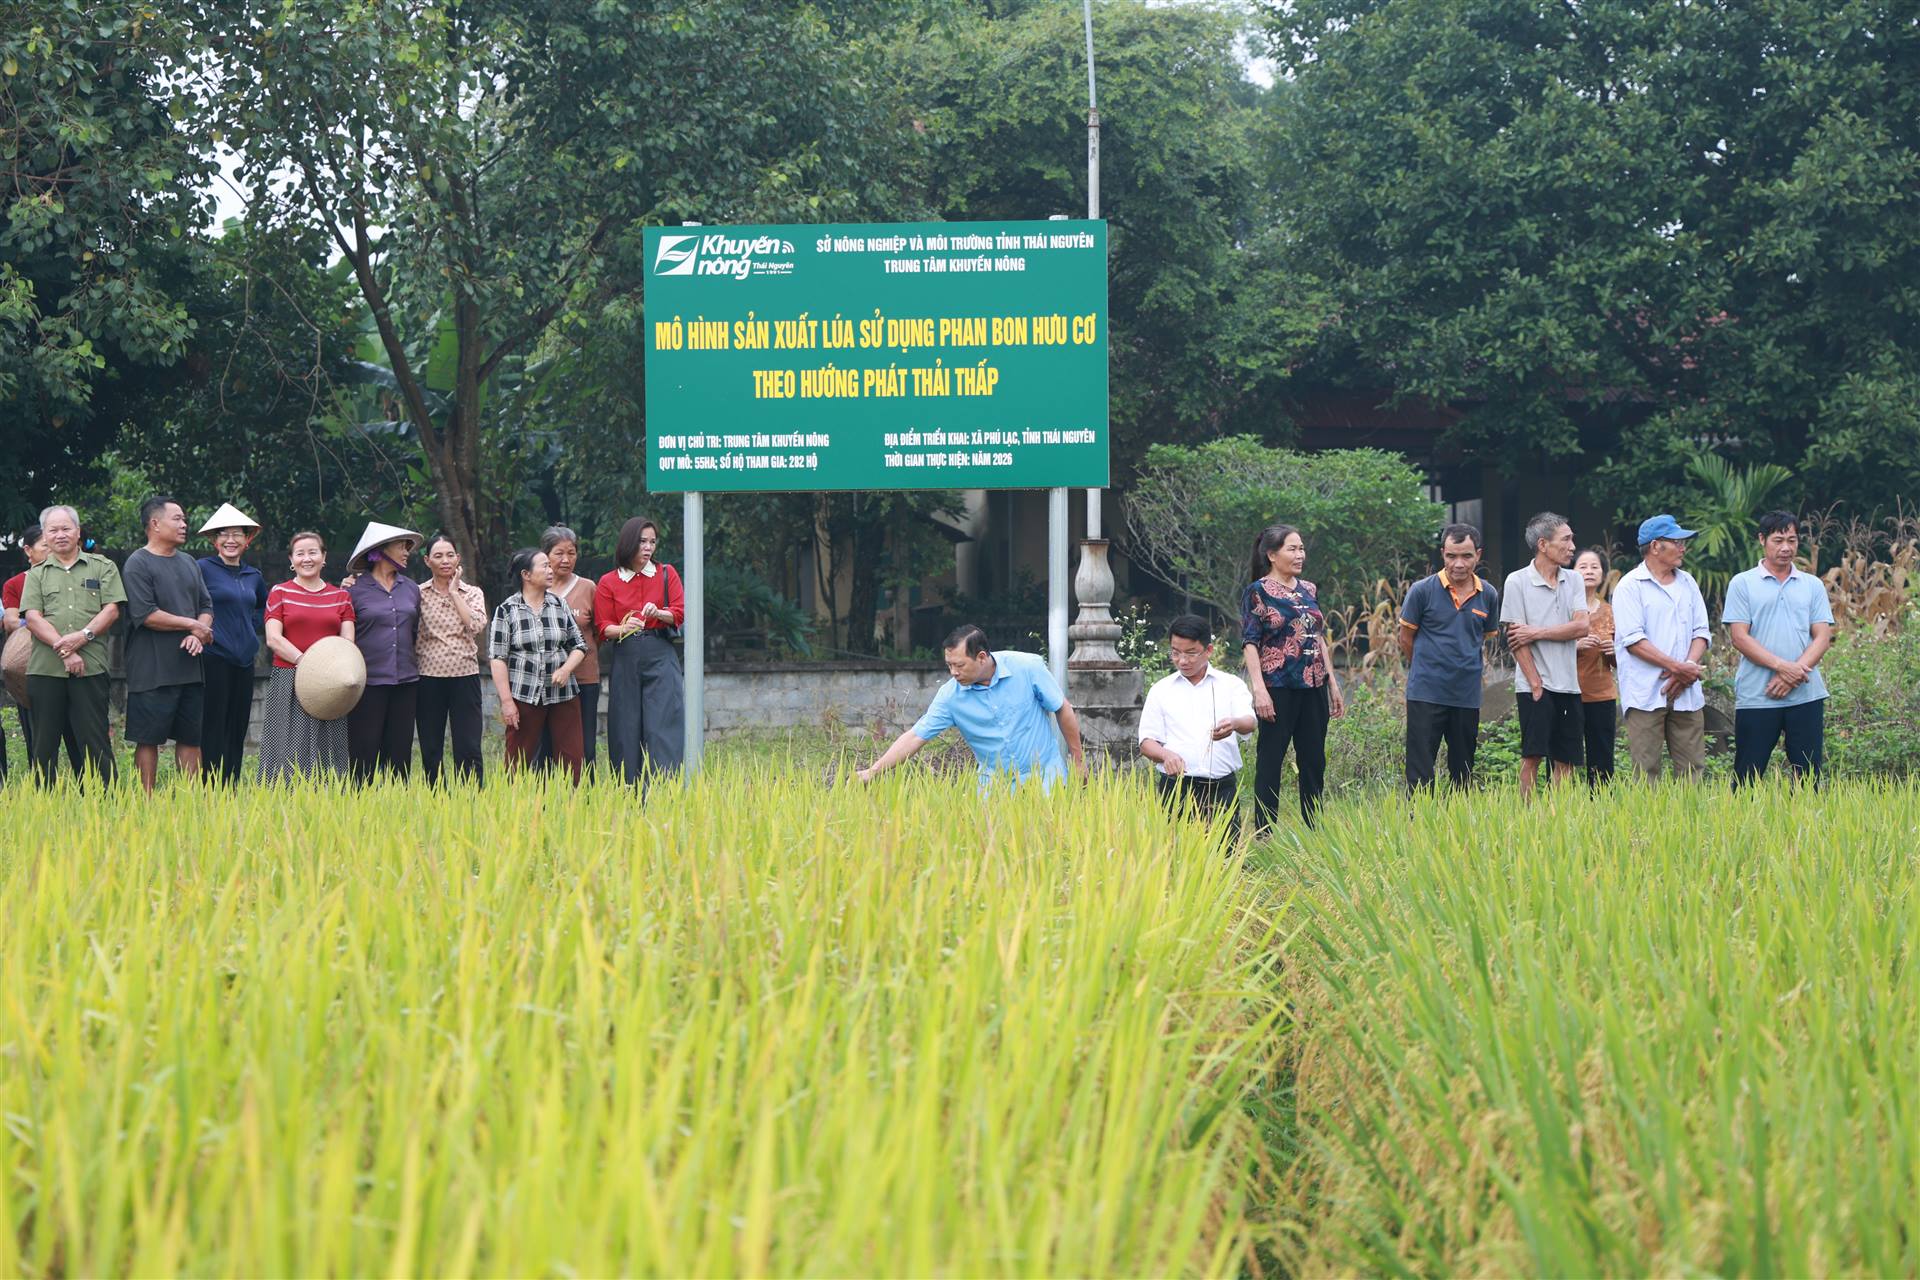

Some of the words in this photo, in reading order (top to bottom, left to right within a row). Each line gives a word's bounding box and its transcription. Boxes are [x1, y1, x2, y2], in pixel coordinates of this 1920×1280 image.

[701, 235, 781, 259] Khuyến
[816, 234, 832, 253] SỞ
[834, 235, 865, 252] NÔNG
[867, 235, 907, 254] NGHIỆP
[909, 234, 924, 251] VÀ
[926, 234, 948, 250] MÔI
[950, 233, 993, 250] TRƯỜNG
[996, 232, 1021, 249] TỈNH
[1023, 232, 1048, 249] THÁI
[1050, 232, 1095, 248] NGUYÊN
[698, 257, 751, 280] nông
[769, 261, 794, 270] Nguyên
[884, 259, 921, 273] TRUNG
[923, 256, 947, 272] TÂM
[950, 254, 992, 272] KHUYẾN
[995, 255, 1026, 271] NÔNG
[656, 315, 683, 350] MÔ
[688, 315, 730, 350] HÌNH
[734, 311, 770, 350] SẢN
[774, 311, 818, 349] XUẤT
[823, 313, 856, 349] LÚA
[860, 307, 885, 349] SỬ
[888, 319, 935, 354] DỤNG
[940, 318, 987, 347] PHAN
[992, 317, 1028, 346] BON
[1072, 313, 1097, 345] CƠ
[753, 369, 796, 399] THEO
[800, 362, 860, 399] HƯỚNG
[864, 362, 908, 398] PHÁT
[912, 358, 951, 397] THẢI
[955, 358, 999, 396] THẤP
[659, 435, 677, 449] ĐƠN
[678, 435, 687, 451] VỊ
[688, 431, 705, 448] CHỦ
[723, 435, 750, 448] TRUNG
[752, 432, 770, 447] TÂM
[772, 430, 804, 447] KHUYẾN
[806, 431, 830, 447] NÔNG
[884, 432, 899, 449] ĐỊA
[948, 432, 970, 445] KHAI:
[971, 429, 983, 445] XÃ
[984, 428, 1001, 445] PHÚ
[1003, 431, 1021, 447] LẠC,
[1022, 427, 1041, 444] TỈNH
[1042, 428, 1061, 444] THÁI
[1063, 428, 1096, 443] NGUYÊN
[659, 457, 676, 471] QUY
[677, 454, 693, 469] MÔ:
[694, 456, 718, 471] 55HA;
[720, 451, 732, 469] SỐ
[733, 453, 745, 472] HỘ
[746, 456, 769, 469] THAM
[771, 455, 788, 468] GIA:
[789, 455, 805, 468] 282
[806, 452, 818, 471] HỘ
[884, 451, 903, 467] THỜI
[905, 454, 925, 467] GIAN
[926, 452, 947, 469] THỰC
[949, 450, 970, 469] HIỆN:
[972, 450, 992, 466] NĂM
[993, 453, 1013, 466] 2026
